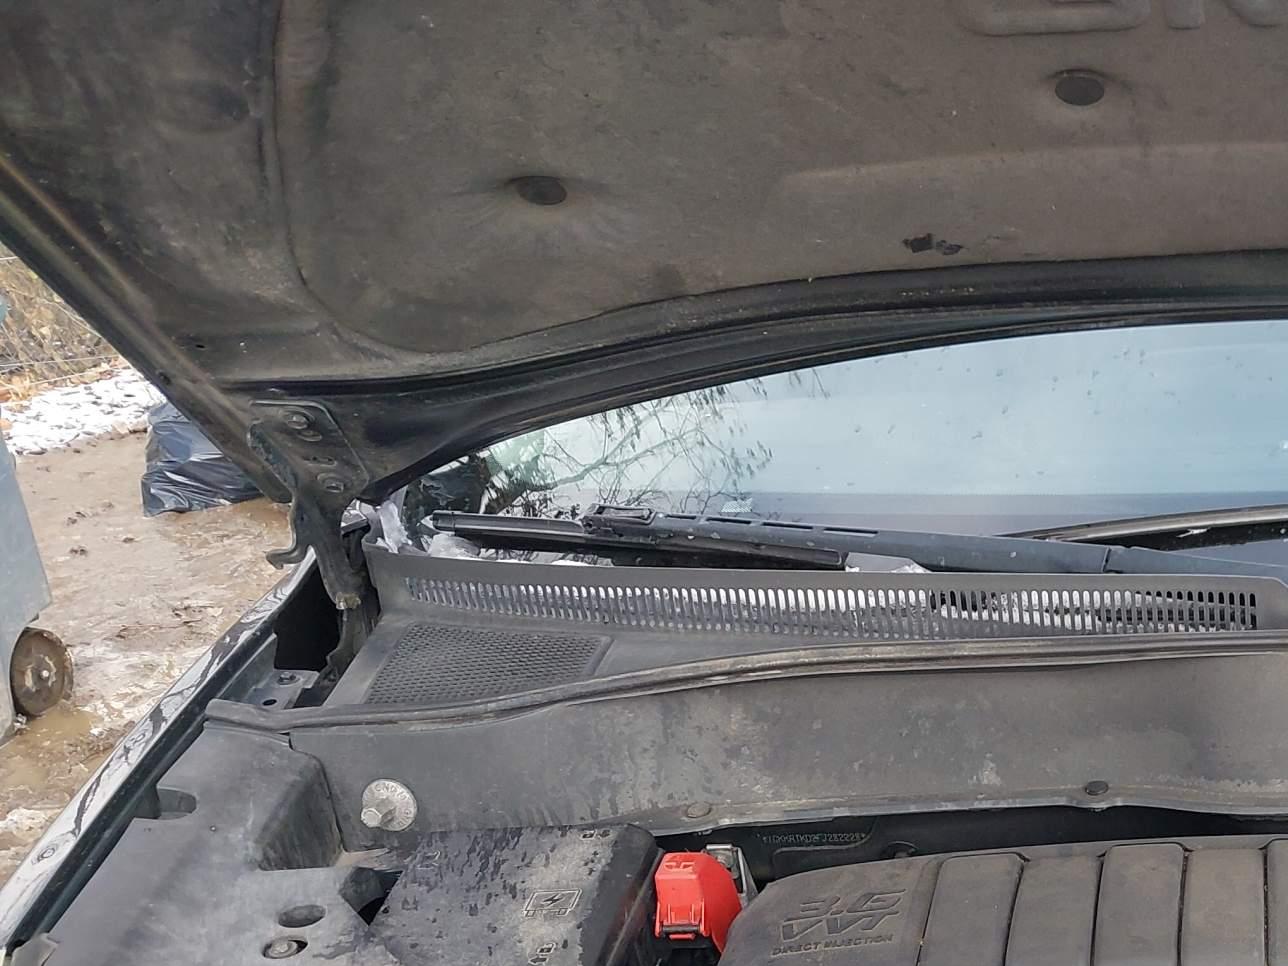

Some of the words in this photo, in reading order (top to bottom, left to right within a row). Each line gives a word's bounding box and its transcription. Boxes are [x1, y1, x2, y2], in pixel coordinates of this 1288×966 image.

[785, 888, 907, 922] 3.6
[781, 910, 901, 942] VVT
[771, 942, 820, 956] DIRECT
[823, 933, 894, 950] INJECTION
